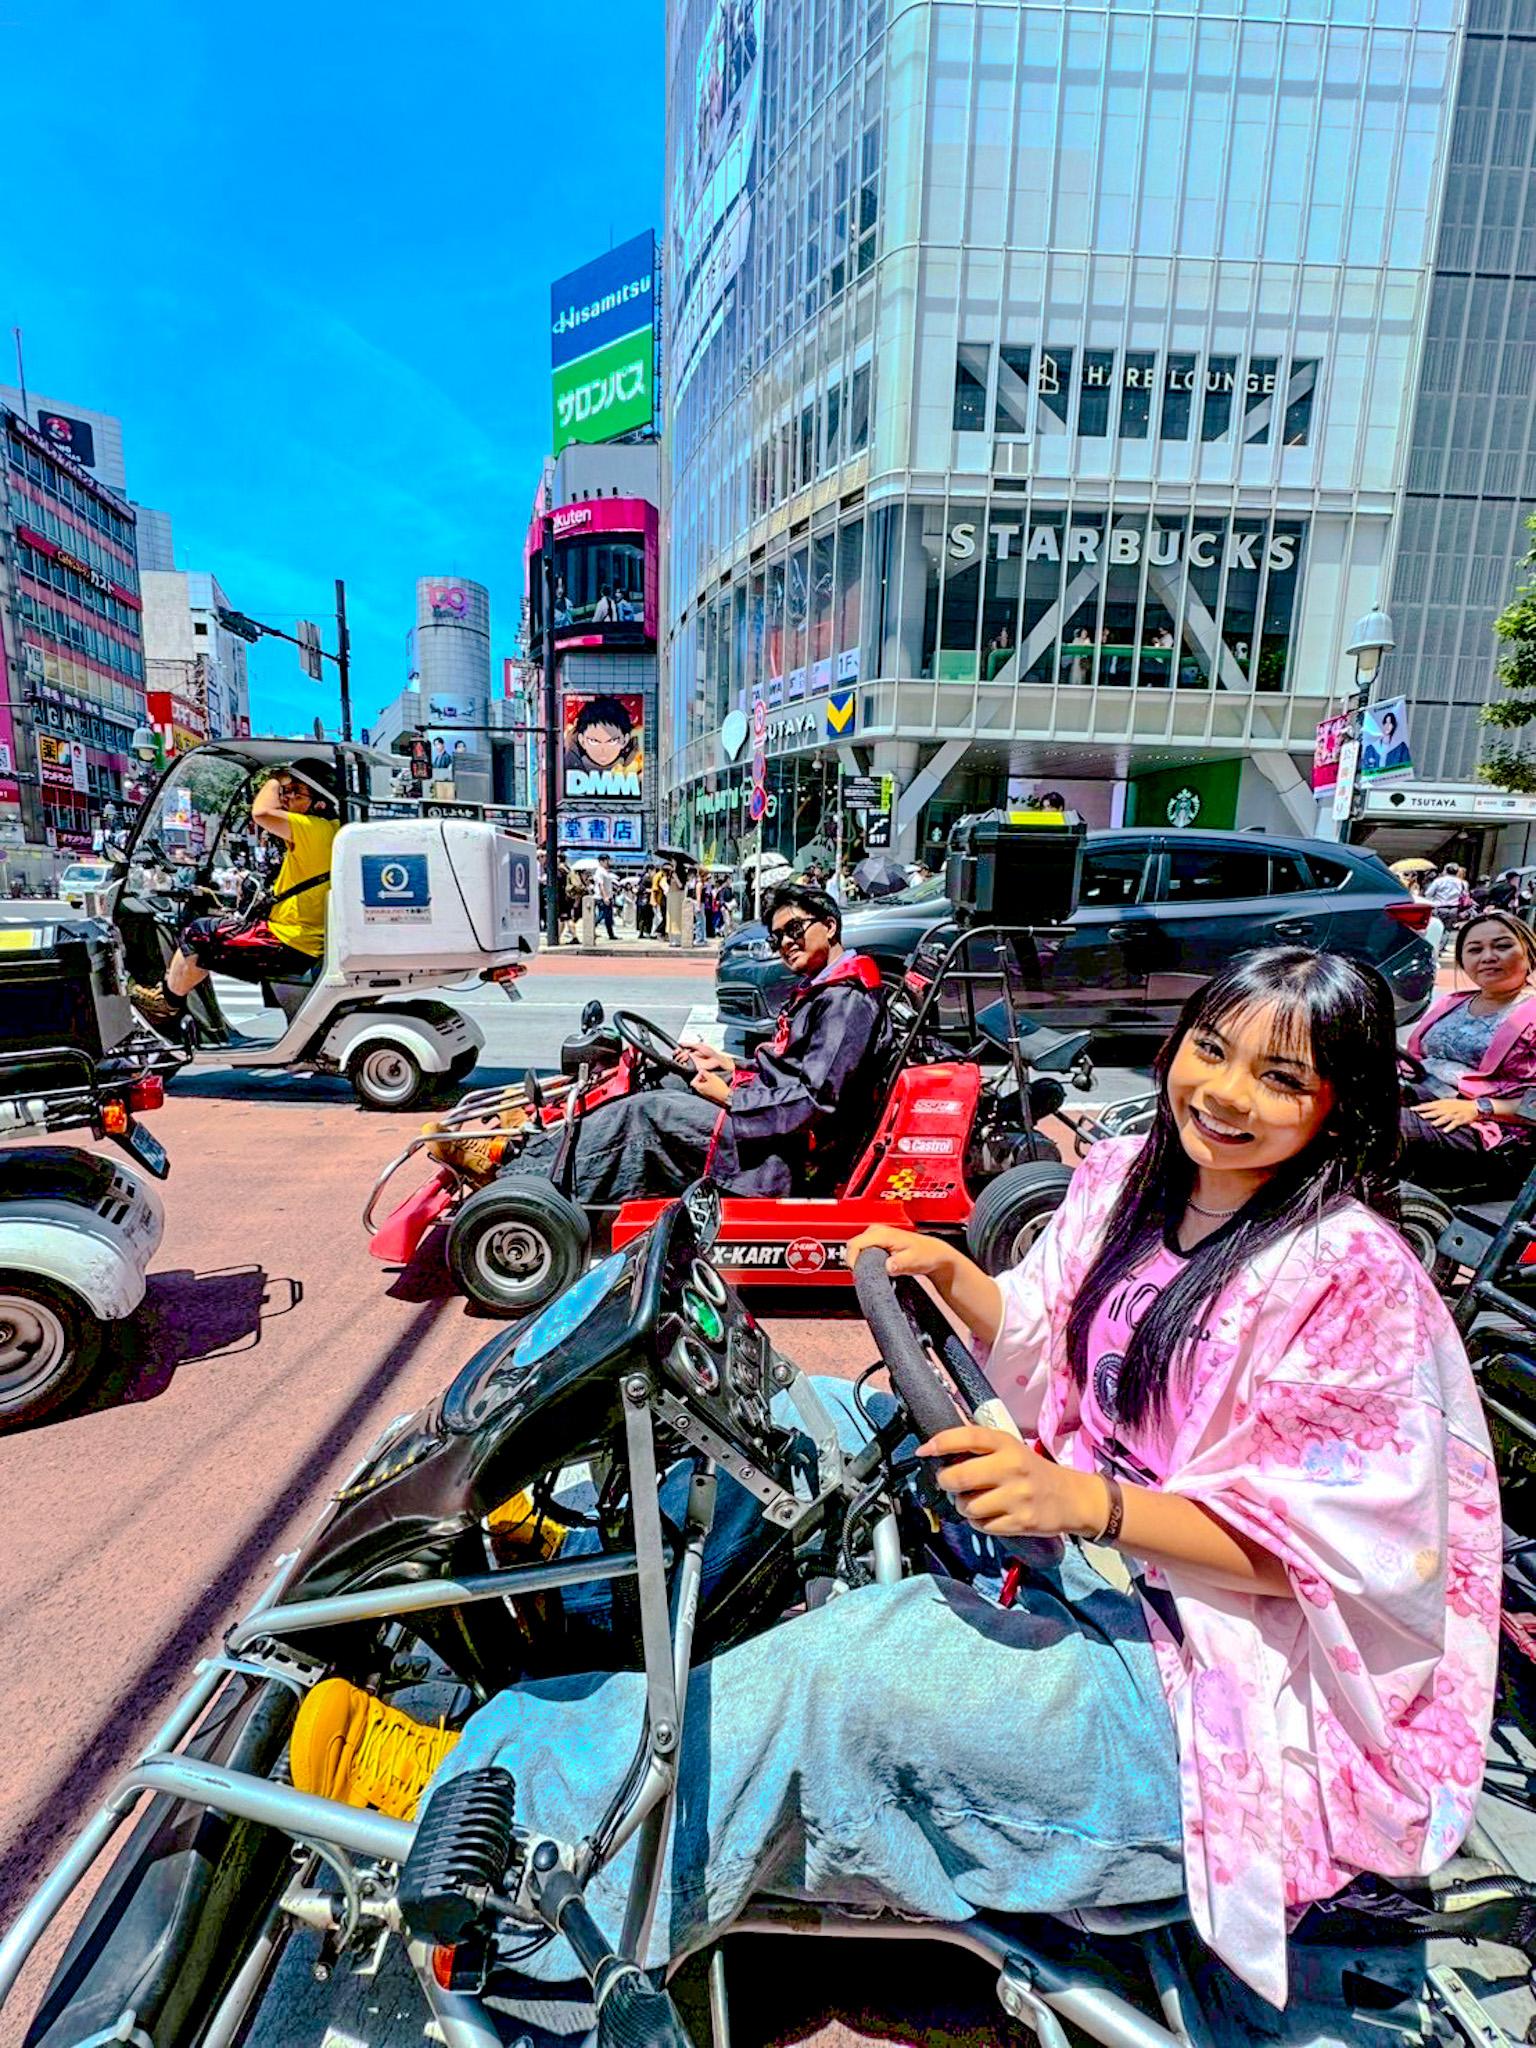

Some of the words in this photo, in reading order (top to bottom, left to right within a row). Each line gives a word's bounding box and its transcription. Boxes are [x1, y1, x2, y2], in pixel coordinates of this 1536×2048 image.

[552, 274, 651, 335] Hisamitsu
[556, 358, 645, 428] サロンパス
[949, 523, 1296, 571] STARBUCKS
[566, 769, 641, 796] DMM
[1411, 797, 1457, 808] TSUTAYA
[565, 819, 633, 840] 堂書店
[911, 1141, 952, 1152] Castrol
[711, 1246, 784, 1264] X-KART
